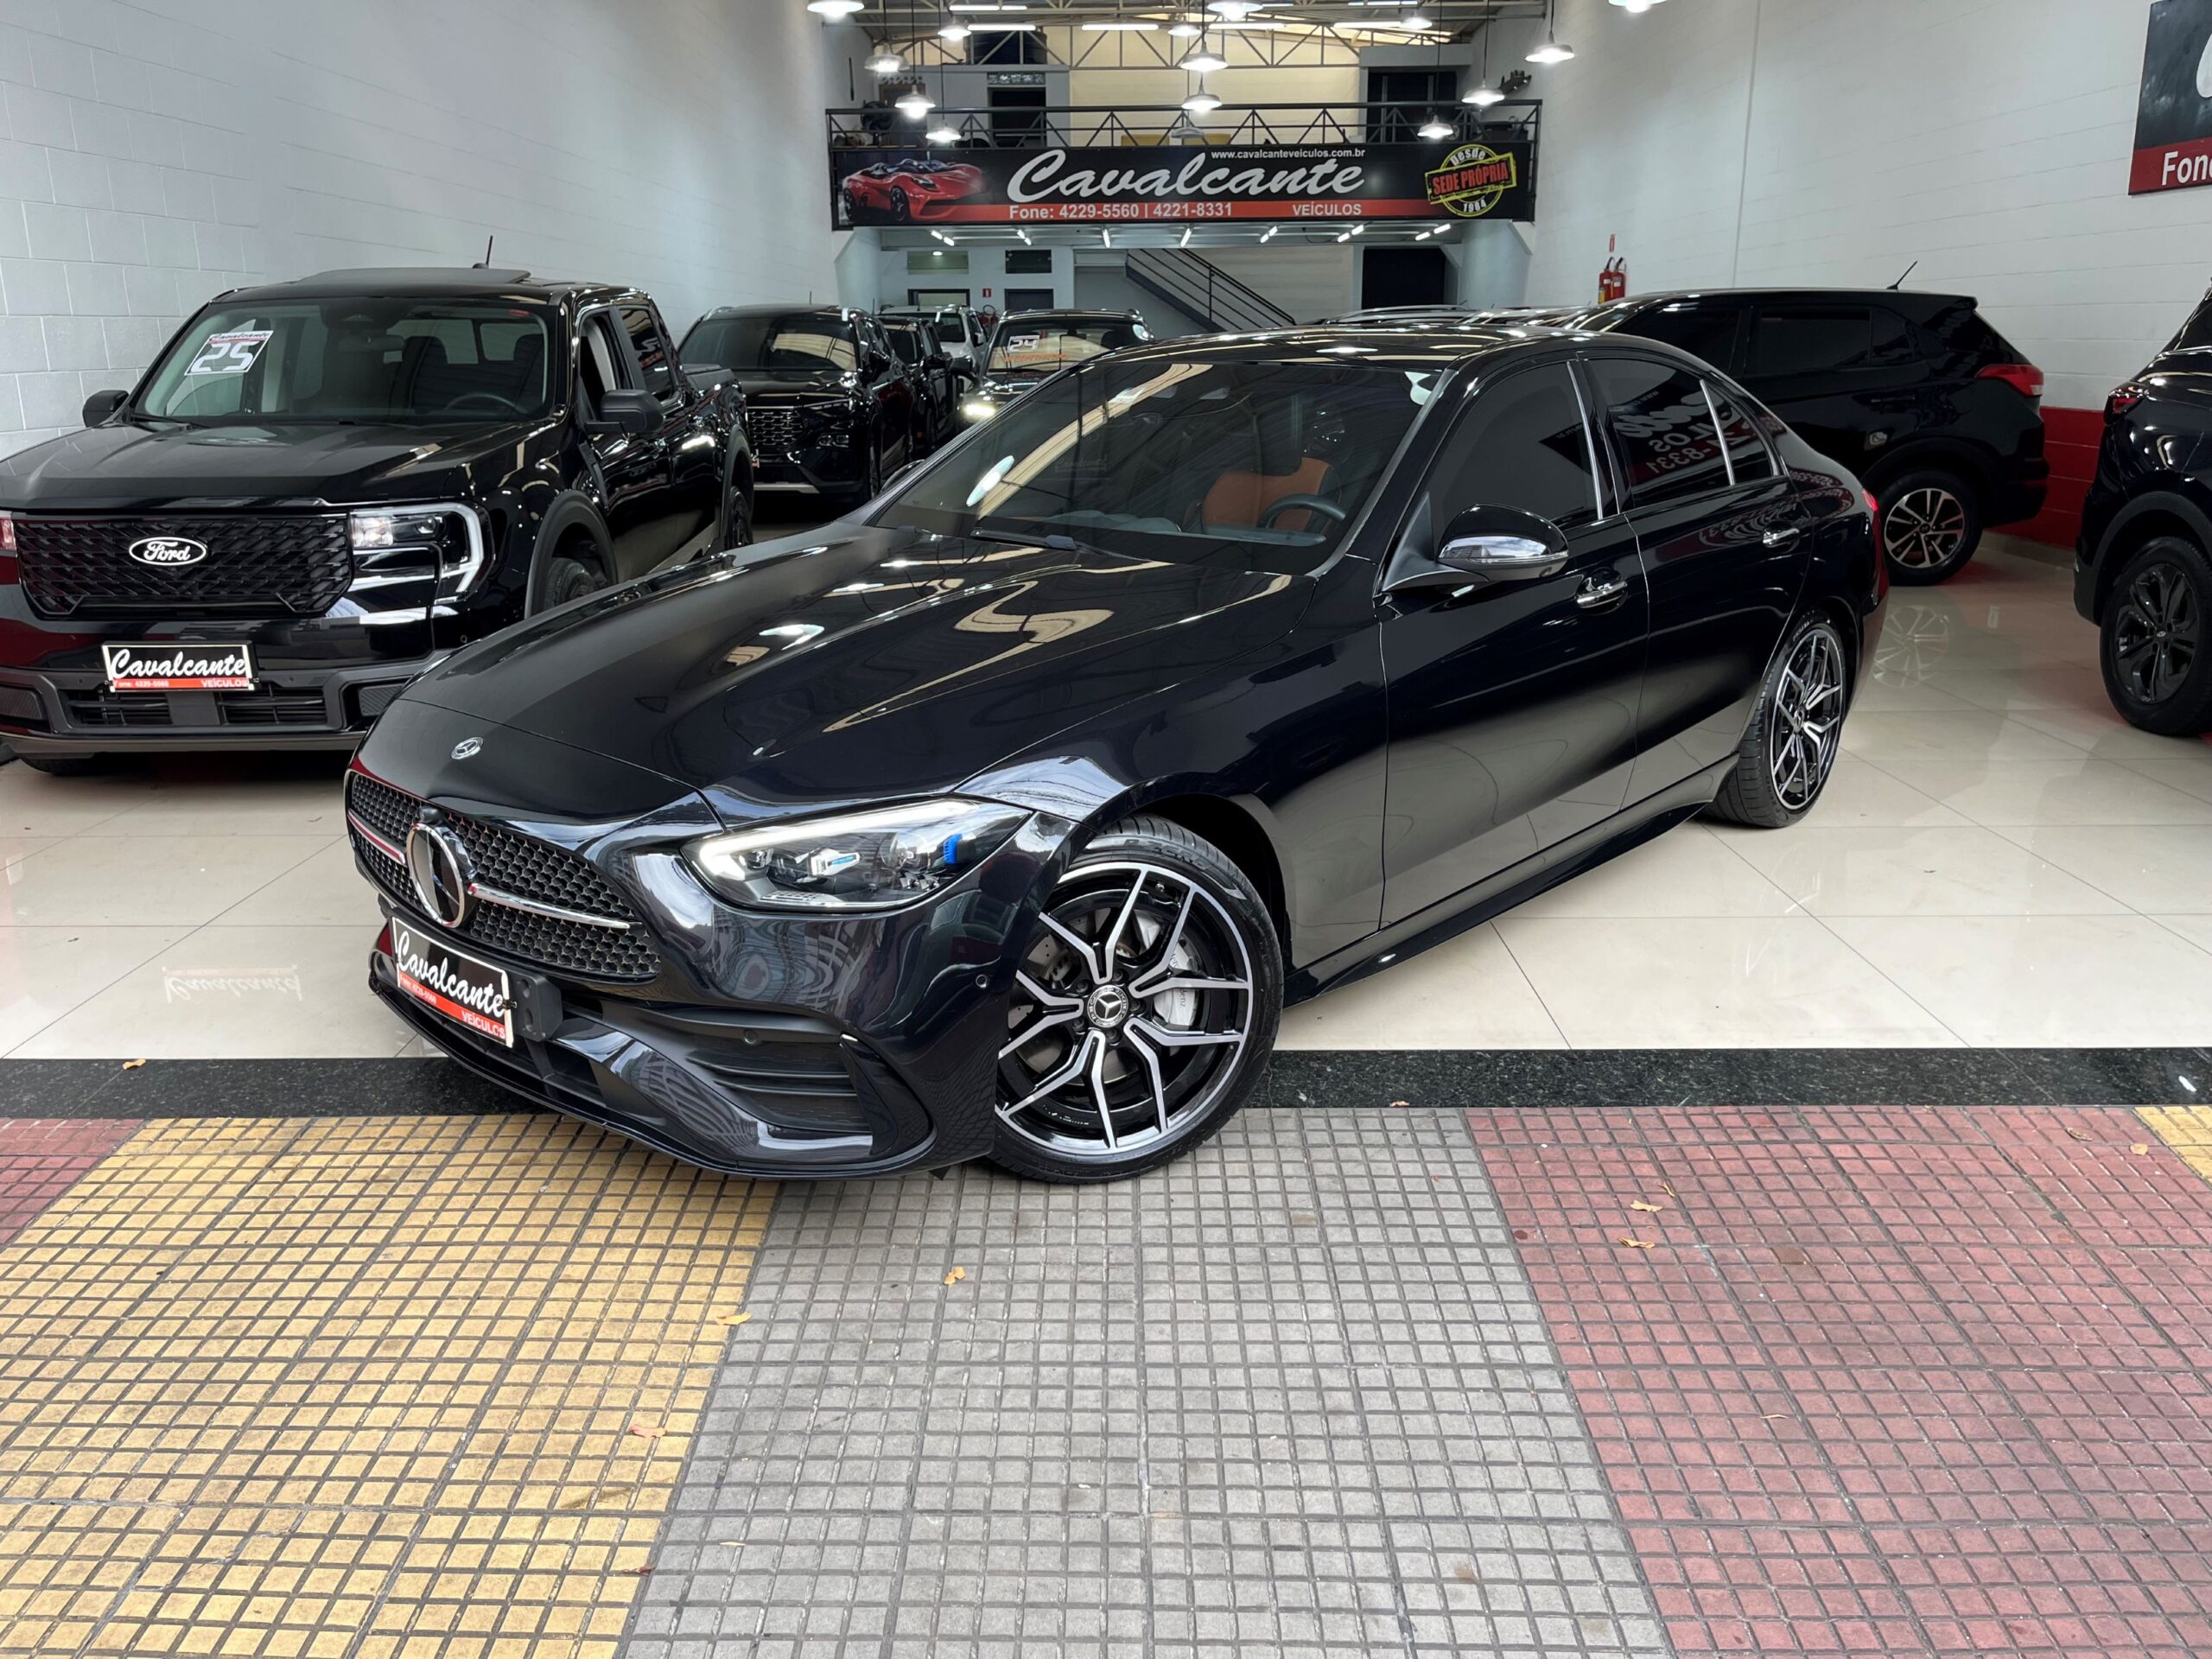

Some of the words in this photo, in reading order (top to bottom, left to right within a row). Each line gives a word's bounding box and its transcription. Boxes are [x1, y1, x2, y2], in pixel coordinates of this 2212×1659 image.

[1211, 149, 1365, 159] www.cavalcanteveiculos.com.br
[1450, 148, 1485, 166] Desde
[1007, 149, 1364, 203] Cavalcante
[1433, 173, 1460, 195] SEDE
[1460, 162, 1509, 189] PRÓPRIA
[2162, 150, 2212, 186] Fon
[1009, 206, 1054, 219] Fone:
[1058, 203, 1140, 219] 4229-5560
[1153, 202, 1232, 218] 4221-8331
[1293, 201, 1363, 216] VEÍCULOS
[1463, 198, 1486, 213] 1984
[190, 341, 260, 372] 25
[1008, 339, 1038, 353] 24
[143, 541, 190, 561] Ford
[111, 649, 245, 679] Cavalcante
[398, 931, 505, 1018] Cavalcante
[461, 1009, 506, 1039] VEÍCULOS
